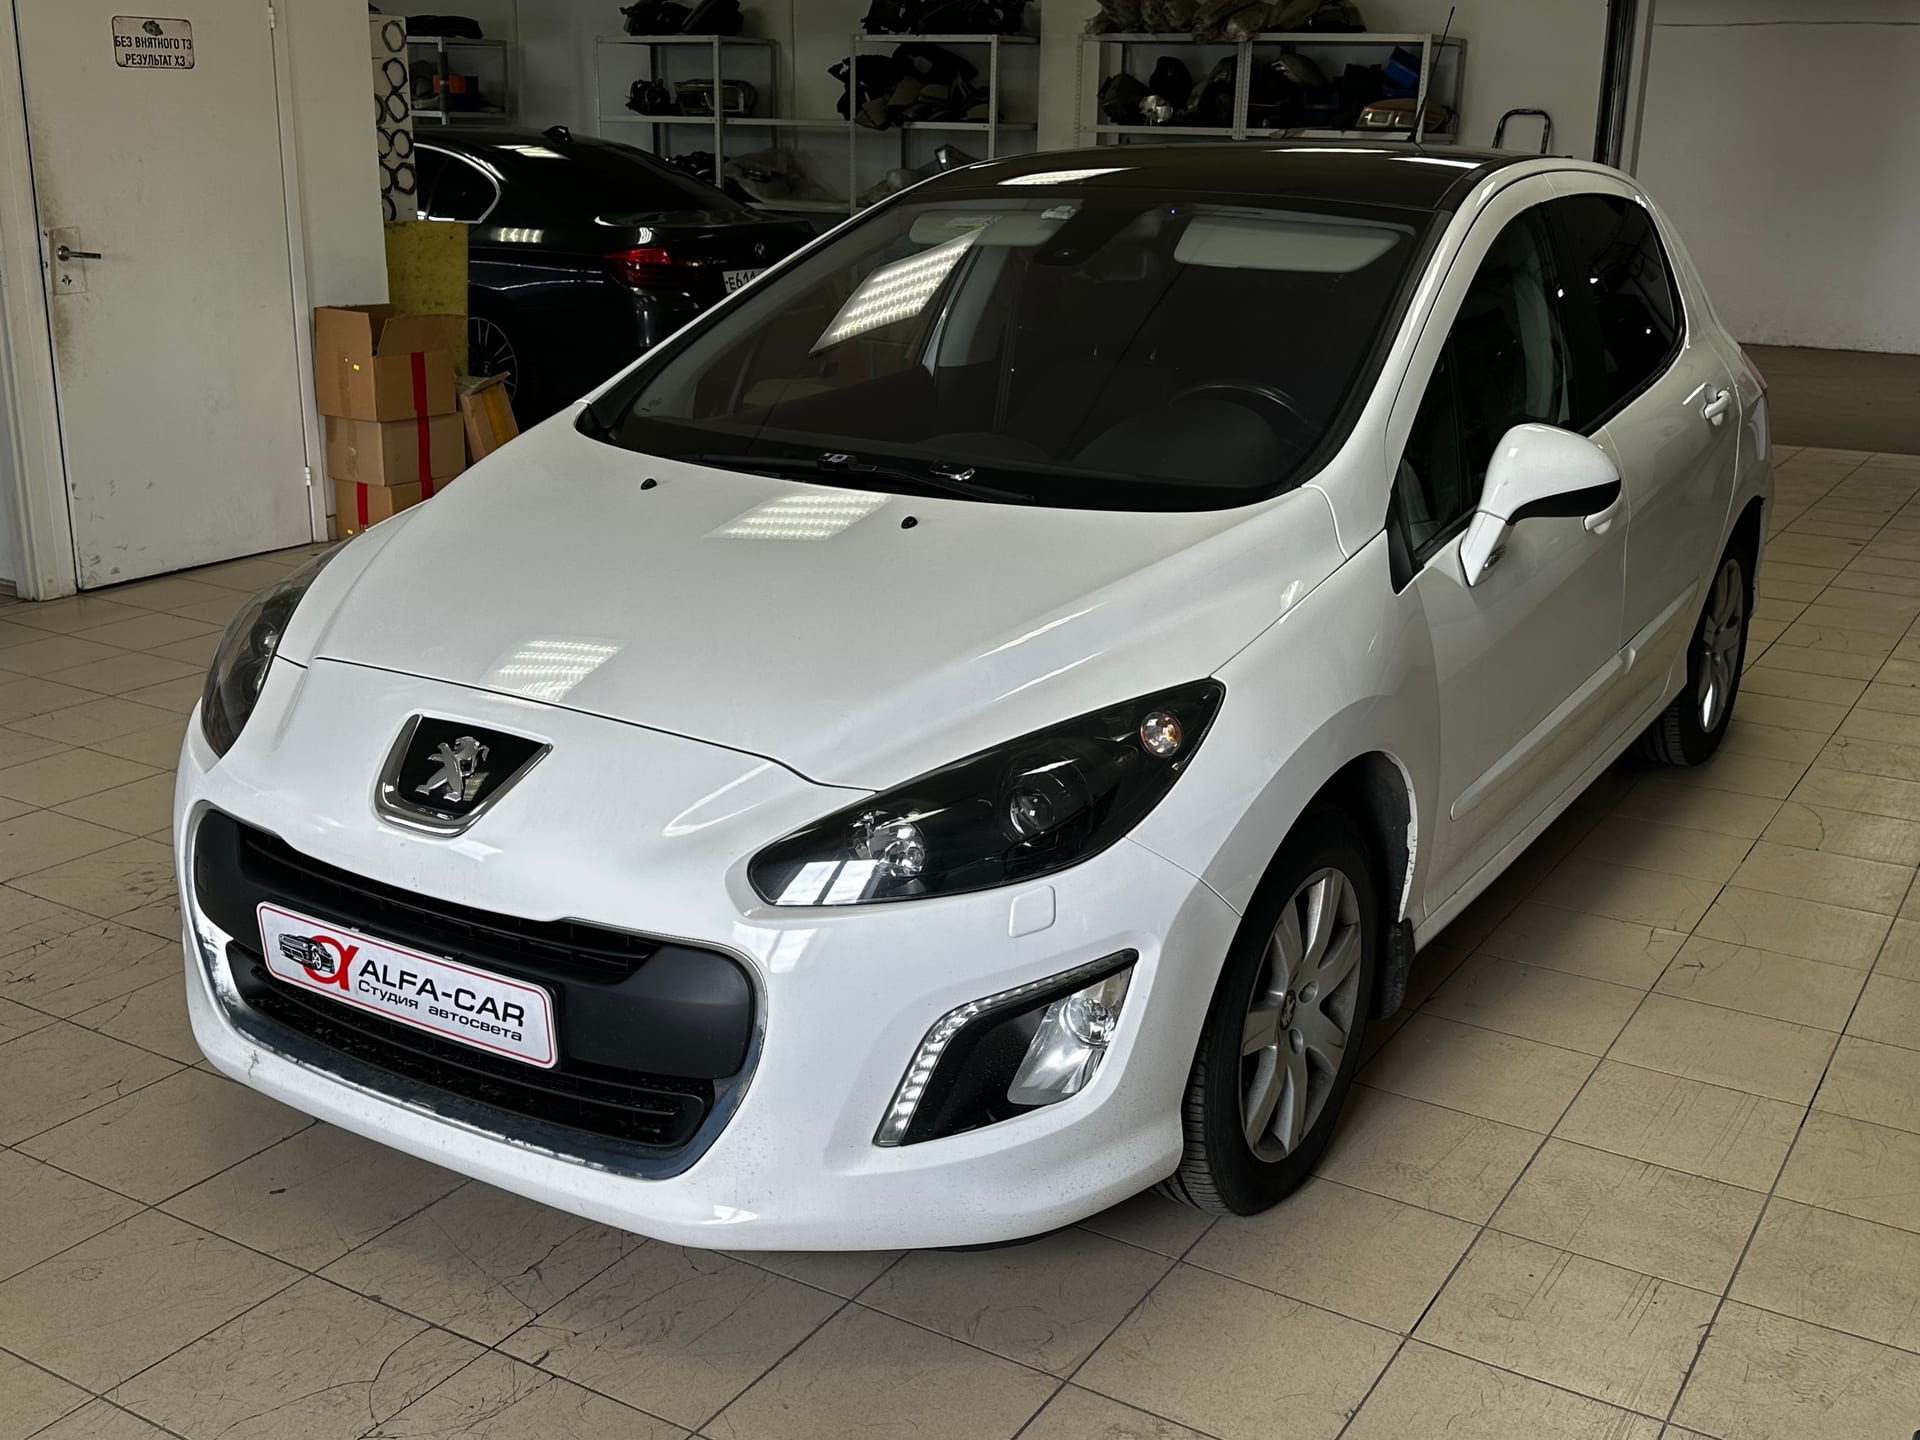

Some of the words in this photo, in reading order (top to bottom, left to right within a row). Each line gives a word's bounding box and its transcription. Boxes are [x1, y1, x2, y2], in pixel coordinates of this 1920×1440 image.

[114, 35, 133, 48] БЕЗ
[134, 36, 180, 50] ВНЯТНОГО
[181, 38, 192, 50] ТЗ
[125, 53, 172, 66] РЕЗУЛЬТАТ
[174, 55, 186, 67] ХЗ
[358, 959, 525, 1027] ALFA-CAR
[358, 980, 419, 1010] Студия
[428, 1005, 523, 1042] автосвета
